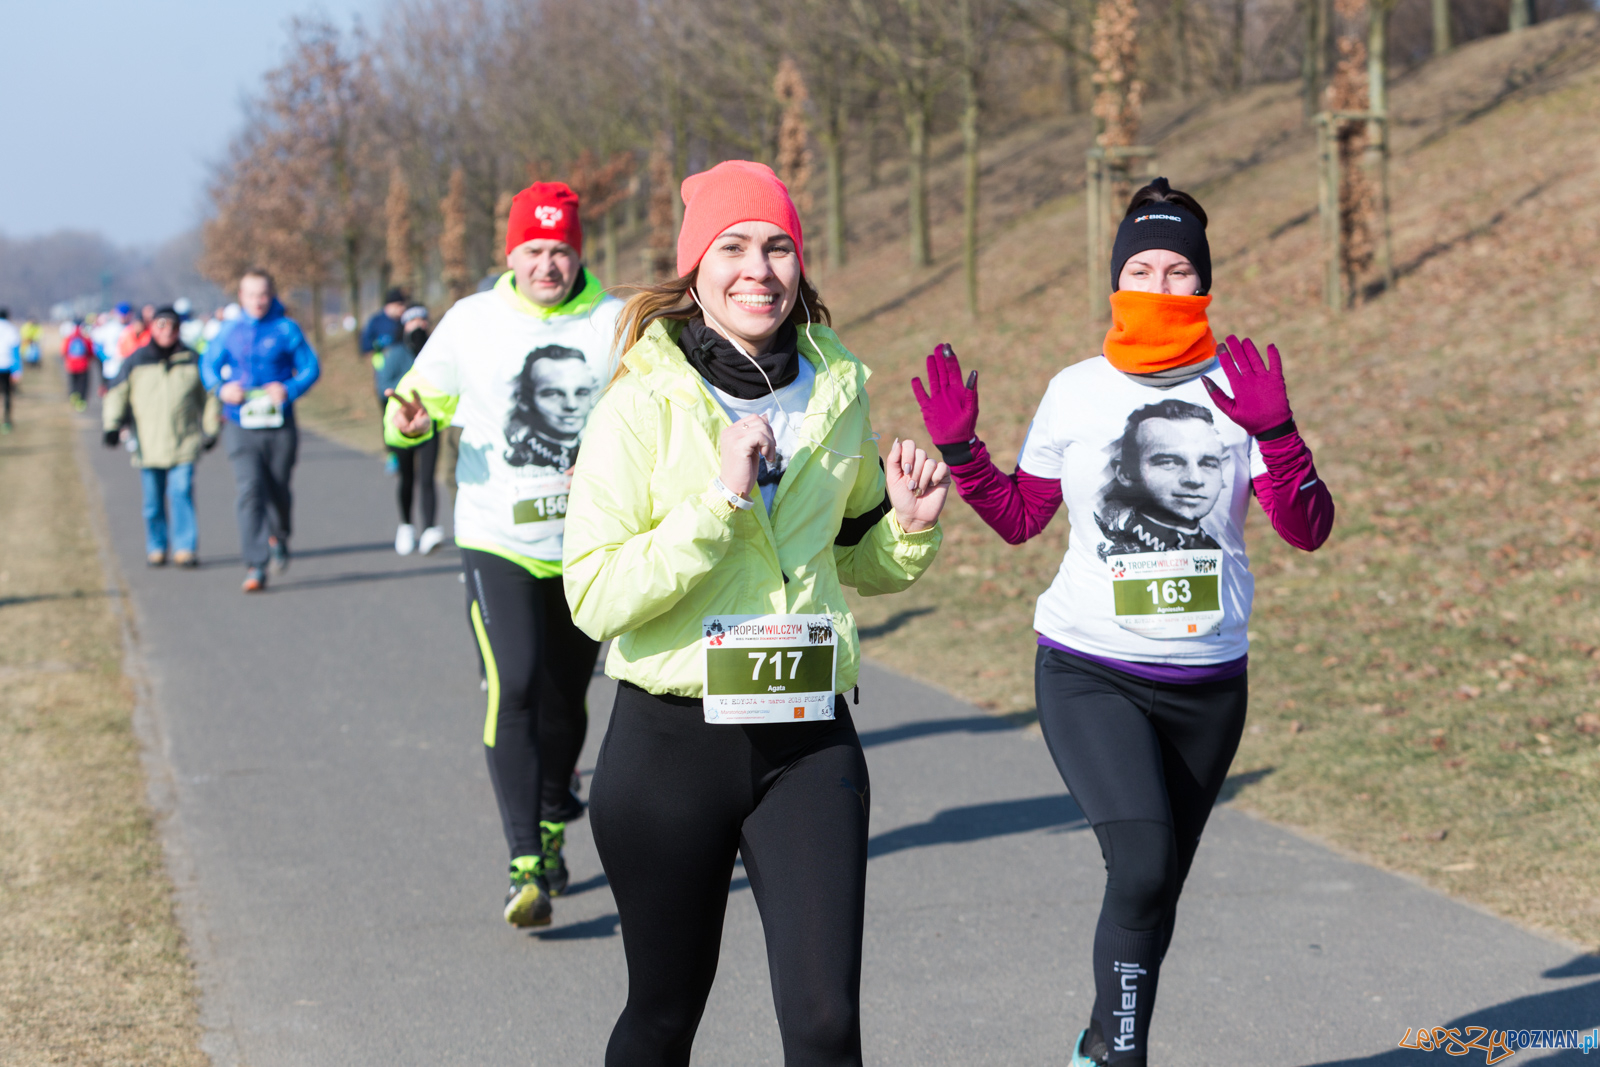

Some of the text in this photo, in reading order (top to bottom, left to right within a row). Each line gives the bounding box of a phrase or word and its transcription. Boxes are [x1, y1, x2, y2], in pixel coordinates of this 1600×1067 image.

[534, 495, 567, 517] 156
[1146, 579, 1192, 605] 163
[727, 624, 803, 636] TROPEMWILCZYM
[748, 651, 803, 681] 717
[767, 685, 786, 693] Agata
[1113, 961, 1147, 1052] kalenji
